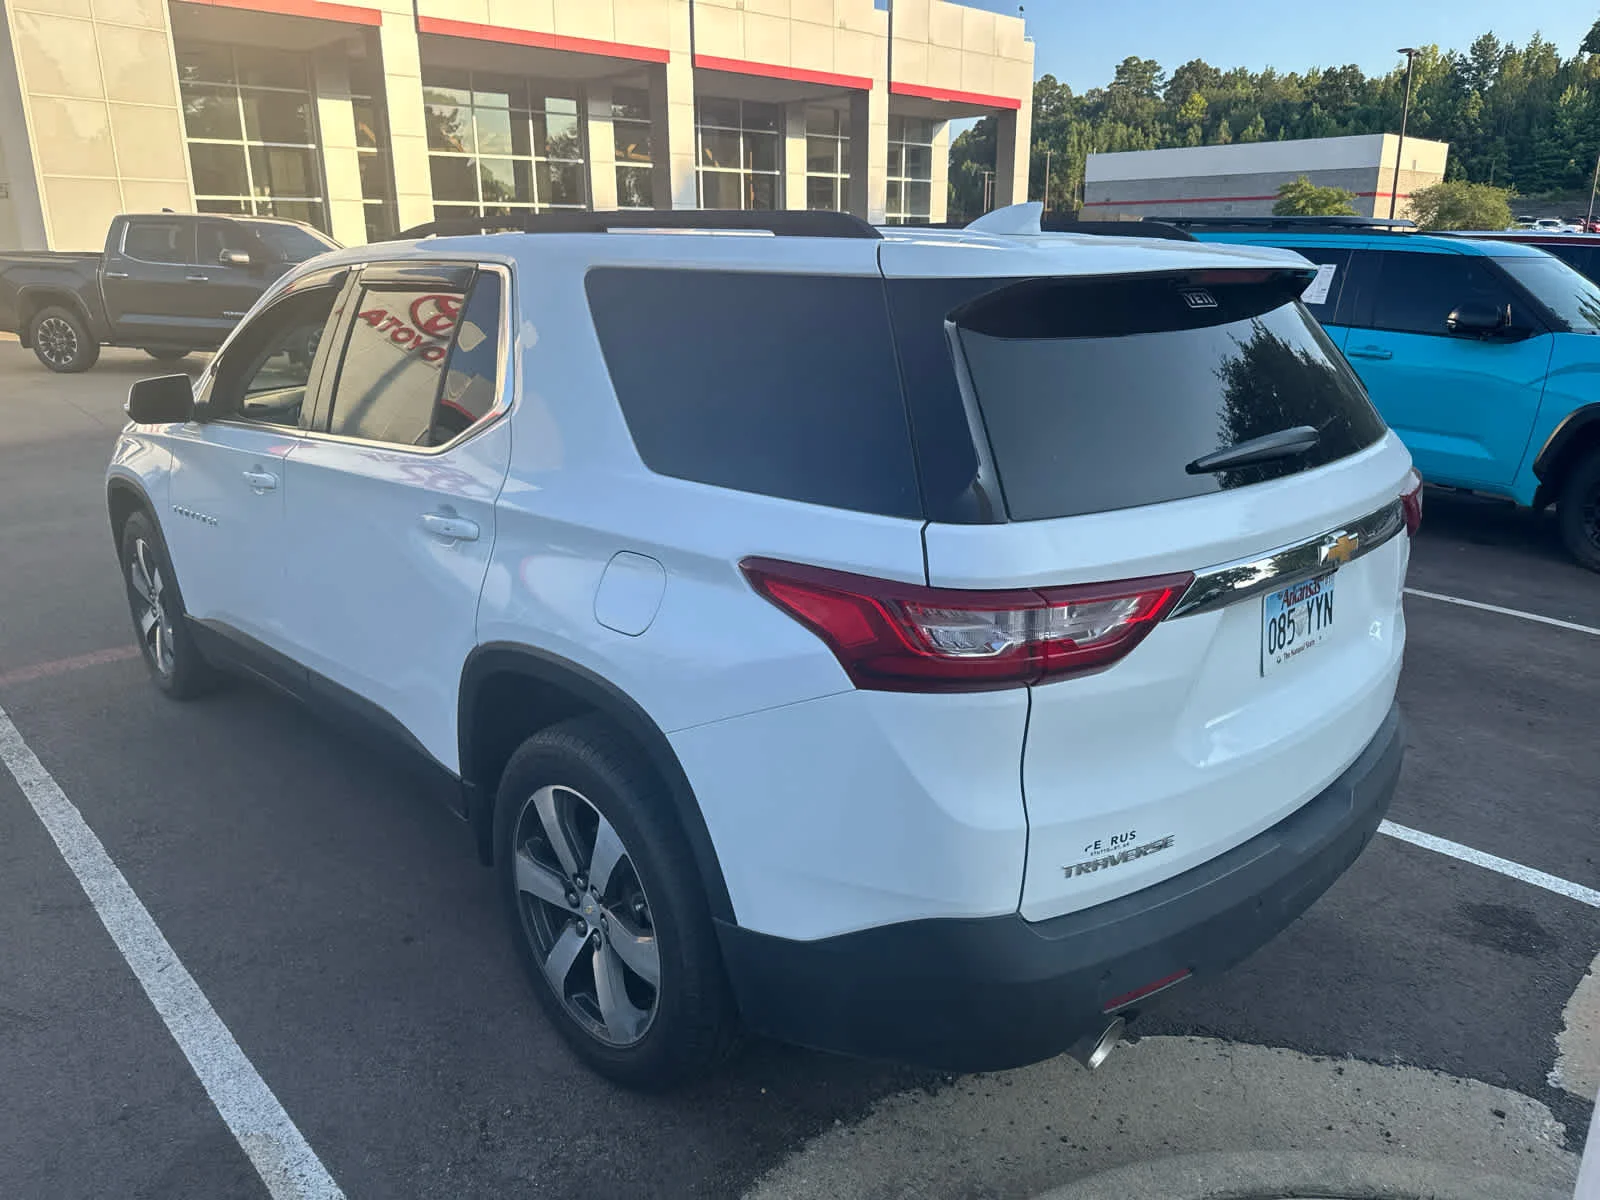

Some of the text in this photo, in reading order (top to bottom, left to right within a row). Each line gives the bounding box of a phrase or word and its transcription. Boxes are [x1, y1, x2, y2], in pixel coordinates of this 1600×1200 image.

[1268, 590, 1334, 655] 085 YYN
[1061, 834, 1175, 879] TRAVERSE
